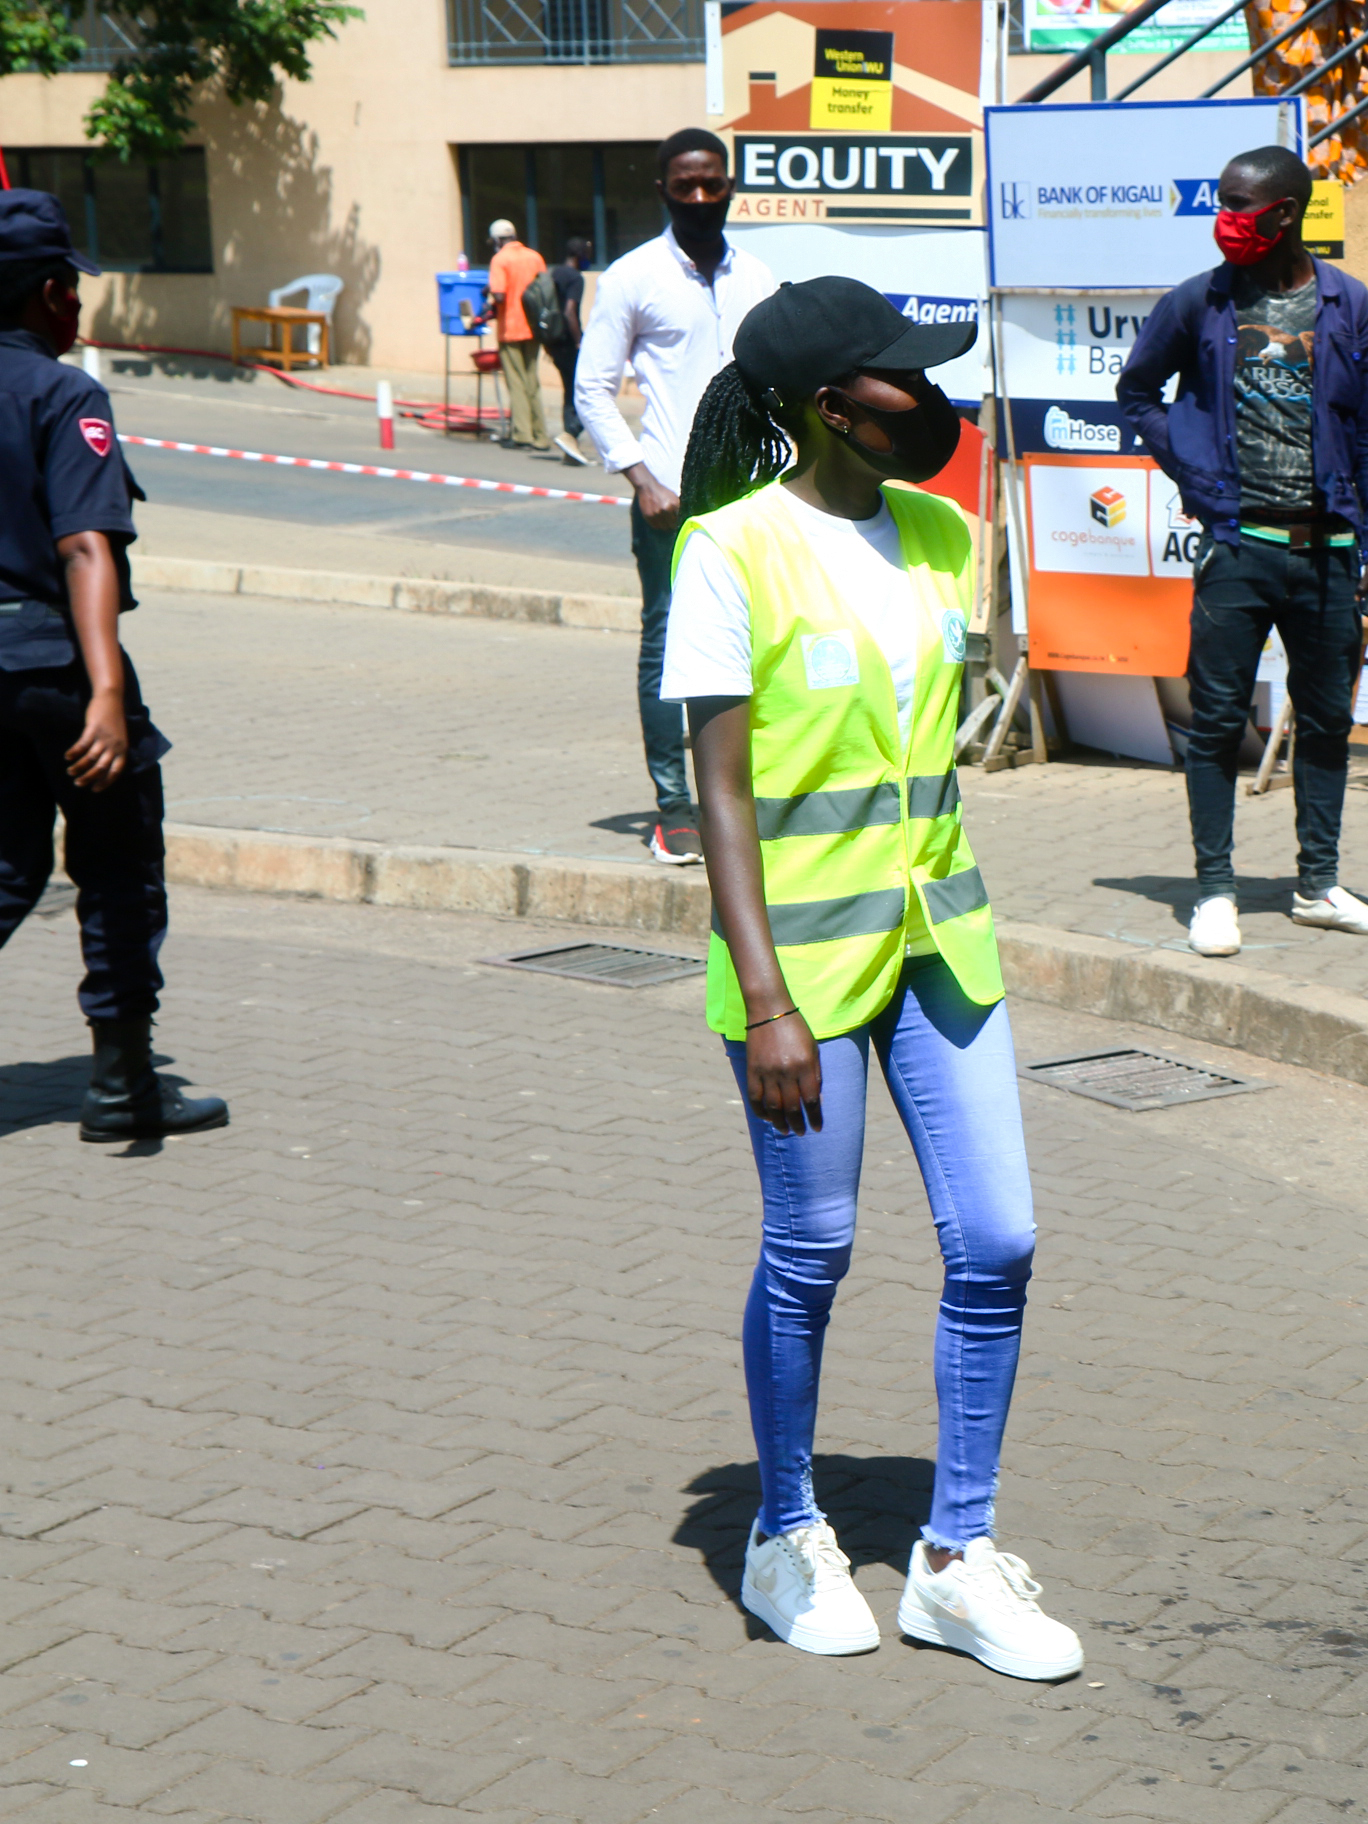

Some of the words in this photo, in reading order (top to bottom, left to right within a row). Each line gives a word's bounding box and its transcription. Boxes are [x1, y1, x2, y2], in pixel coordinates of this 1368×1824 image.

[824, 47, 865, 62] Western
[832, 86, 870, 101] Money
[827, 102, 874, 114] transfer
[743, 142, 960, 191] EQUITY
[1038, 186, 1083, 205] BANK
[1085, 186, 1108, 204] OF
[1110, 185, 1164, 203] KIGALI
[737, 198, 825, 217] AGENT
[901, 296, 978, 325] Agent
[1051, 528, 1136, 552] cogebanque
